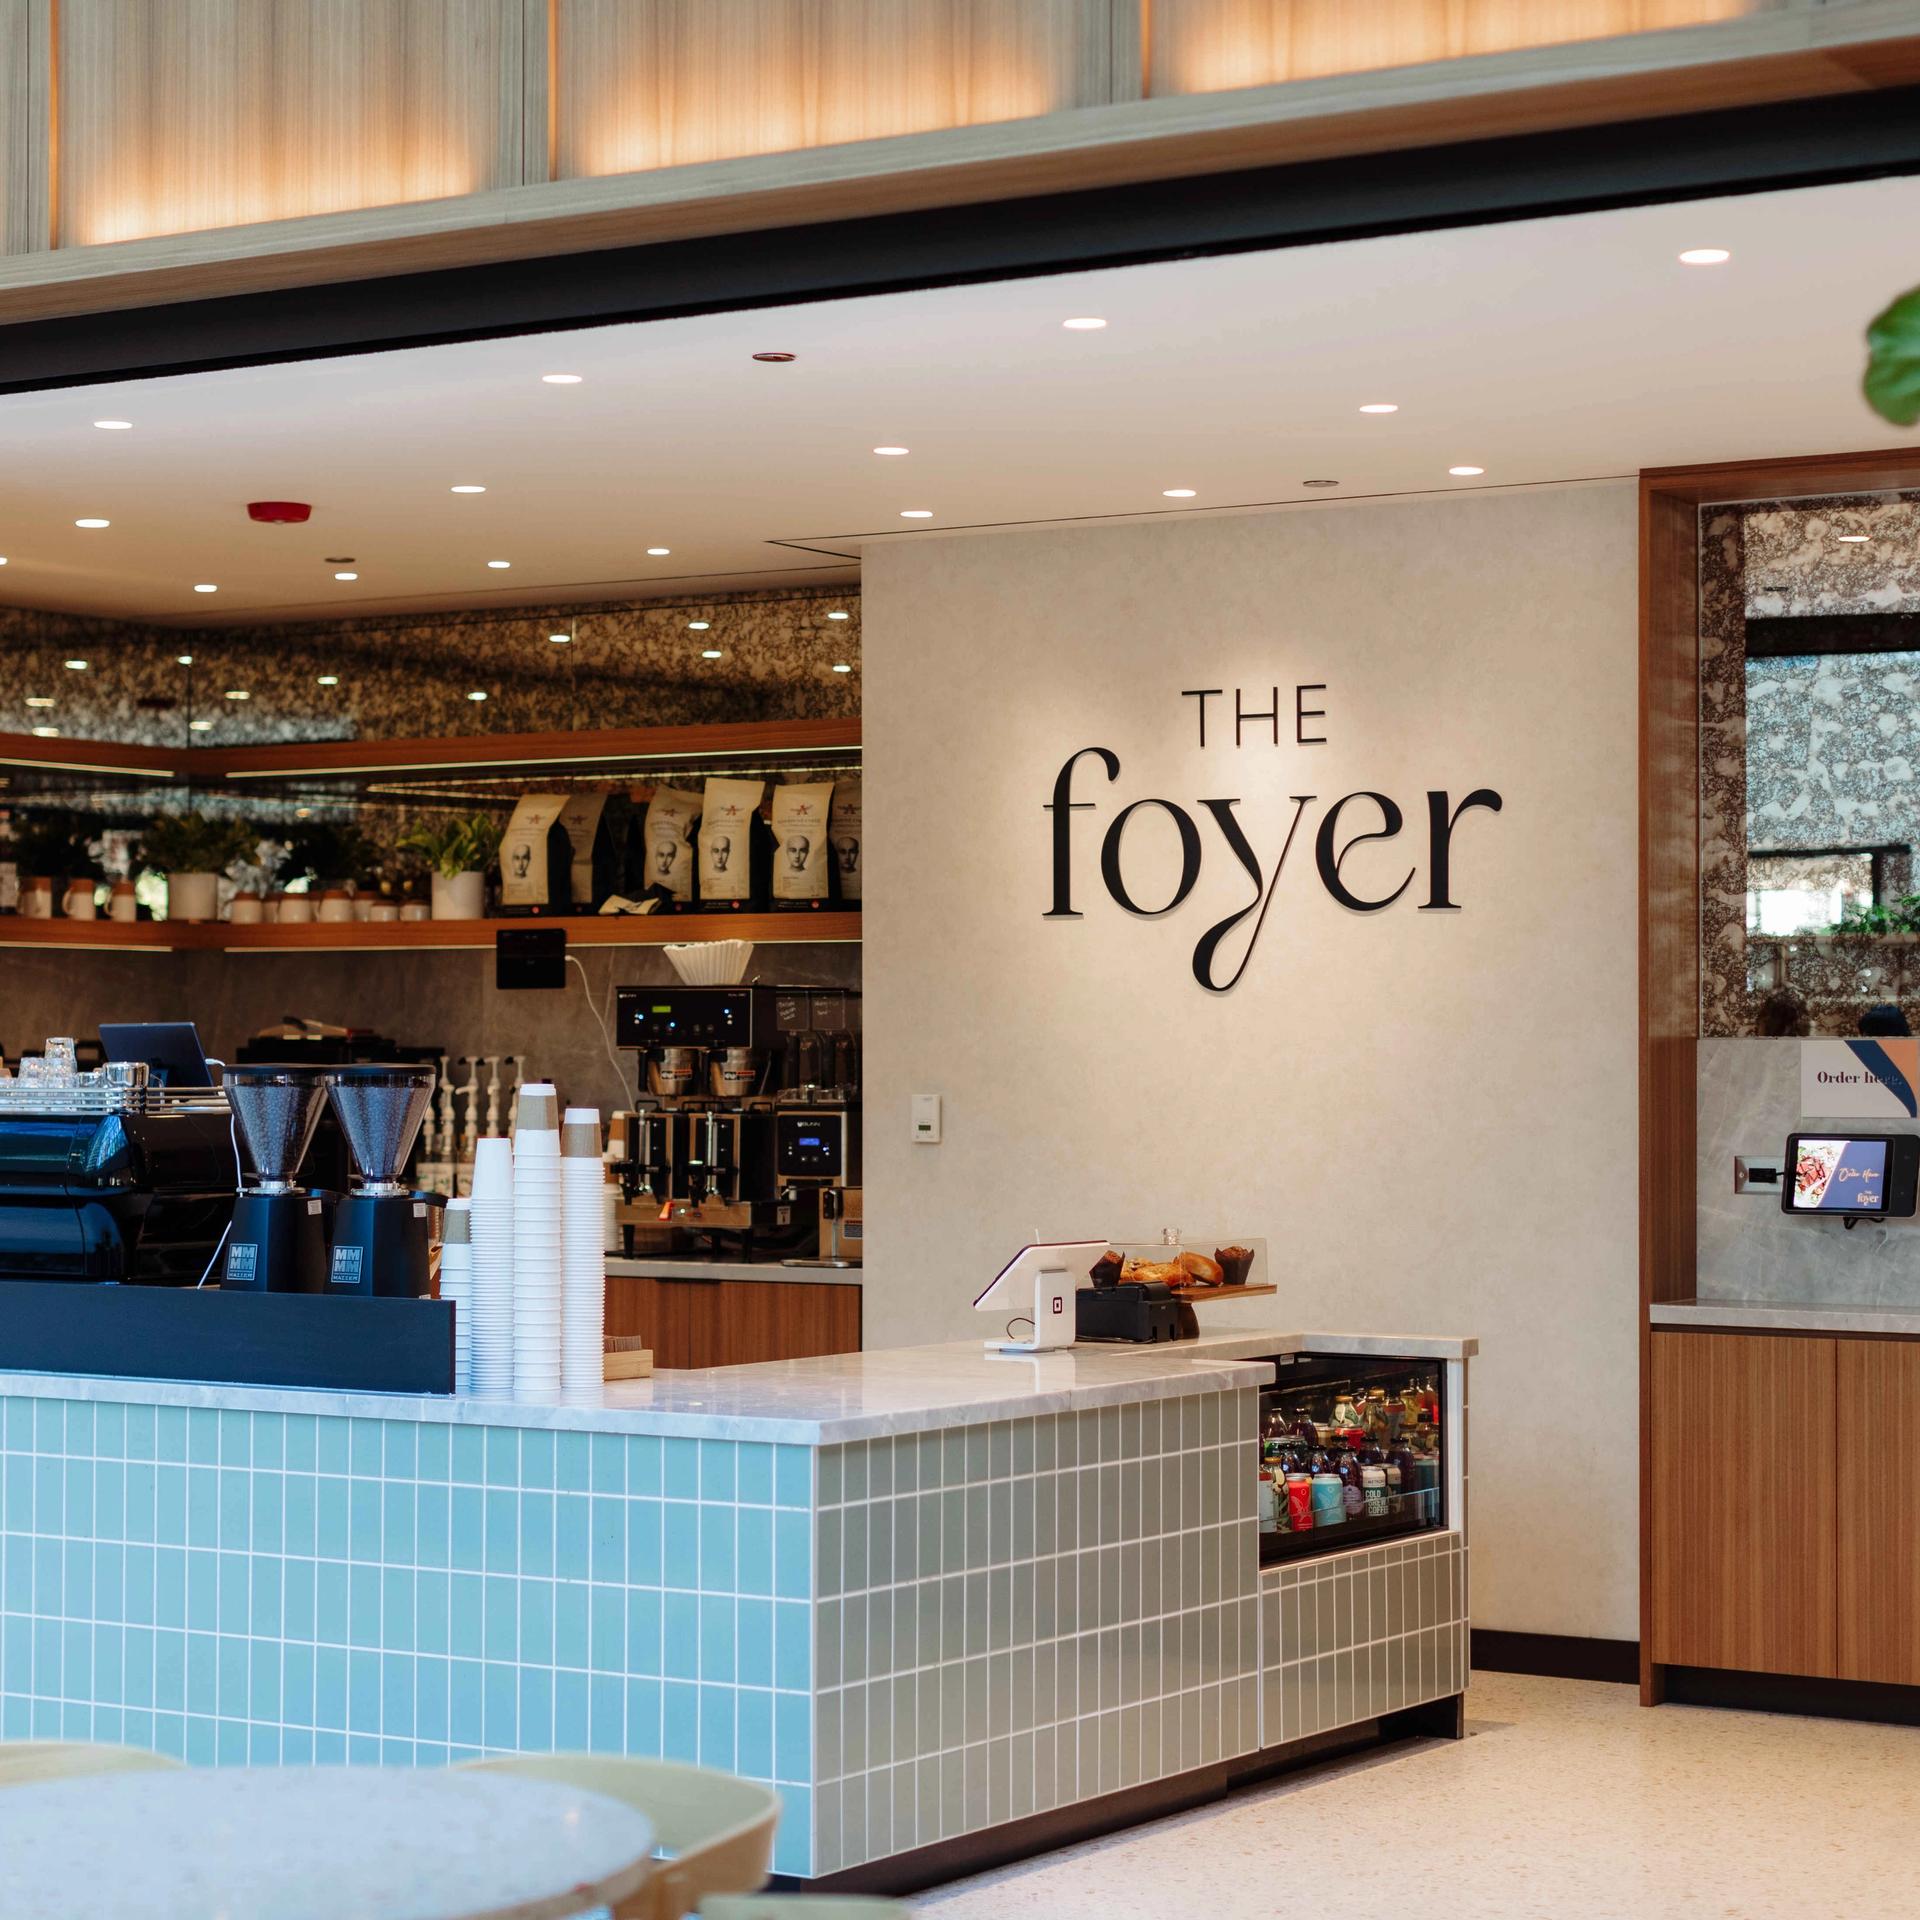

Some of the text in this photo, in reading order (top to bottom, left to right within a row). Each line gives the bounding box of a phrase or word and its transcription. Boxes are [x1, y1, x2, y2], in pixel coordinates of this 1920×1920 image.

[1181, 684, 1327, 748] THE
[1042, 746, 1503, 993] foyer
[1817, 1071, 1860, 1084] Order
